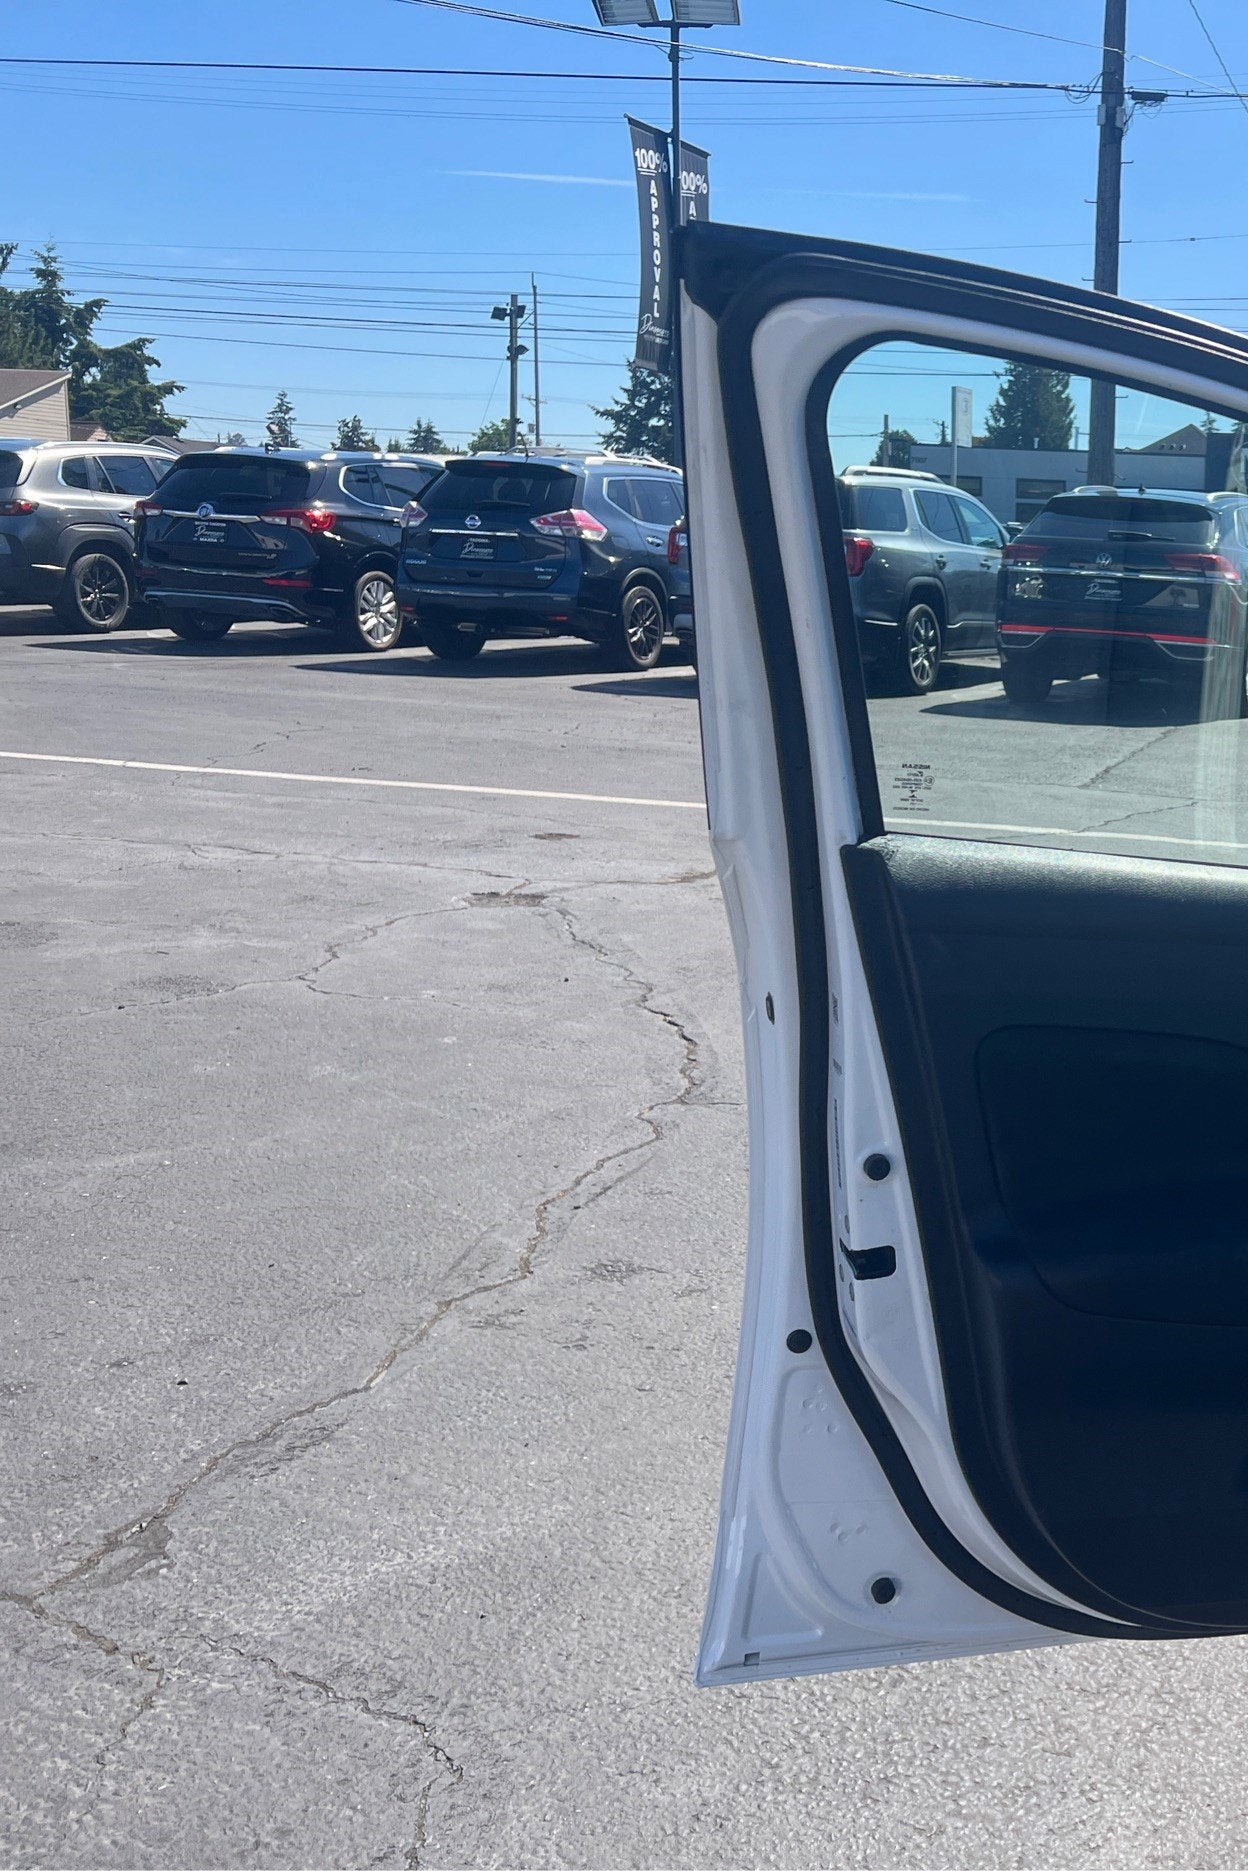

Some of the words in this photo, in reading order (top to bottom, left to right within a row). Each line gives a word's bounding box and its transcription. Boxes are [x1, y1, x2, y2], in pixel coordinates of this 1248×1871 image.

[635, 148, 668, 173] 100%
[679, 171, 707, 194] 00%
[649, 180, 661, 317] APPROVAL
